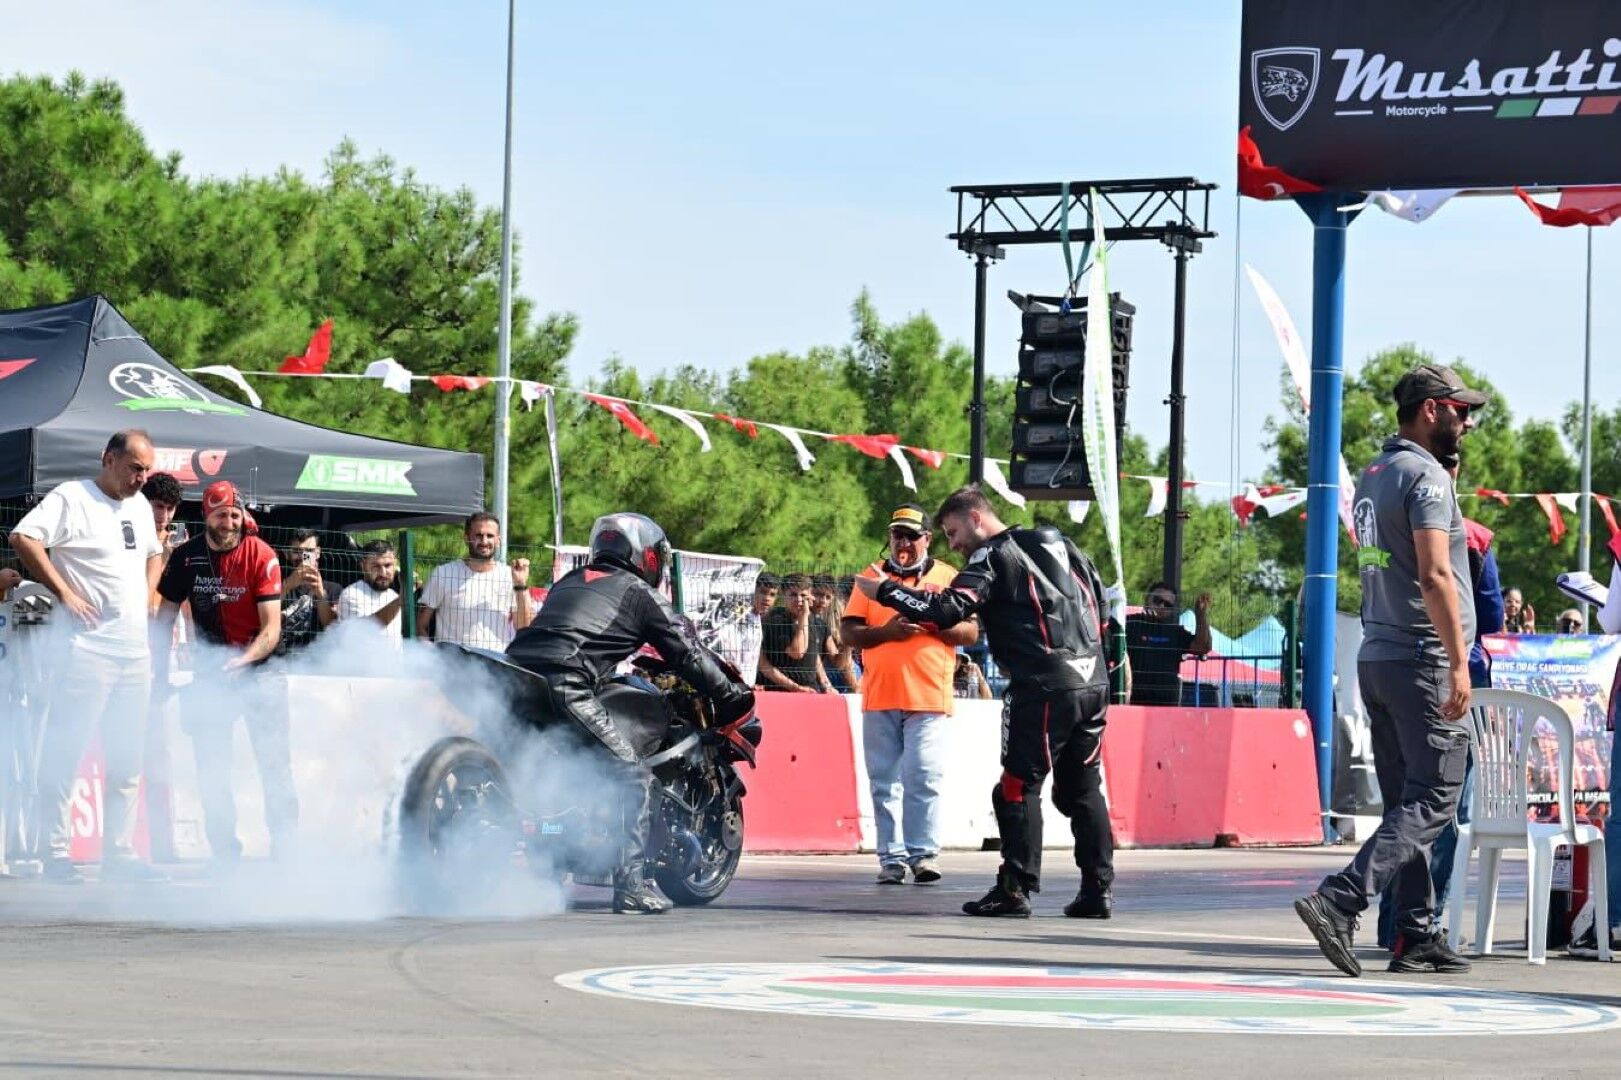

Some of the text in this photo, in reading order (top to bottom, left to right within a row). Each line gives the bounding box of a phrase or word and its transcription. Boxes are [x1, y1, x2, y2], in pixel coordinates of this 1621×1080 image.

[1331, 37, 1621, 102] Musatti
[1386, 104, 1447, 118] Motorcycle
[331, 460, 413, 486] SMK
